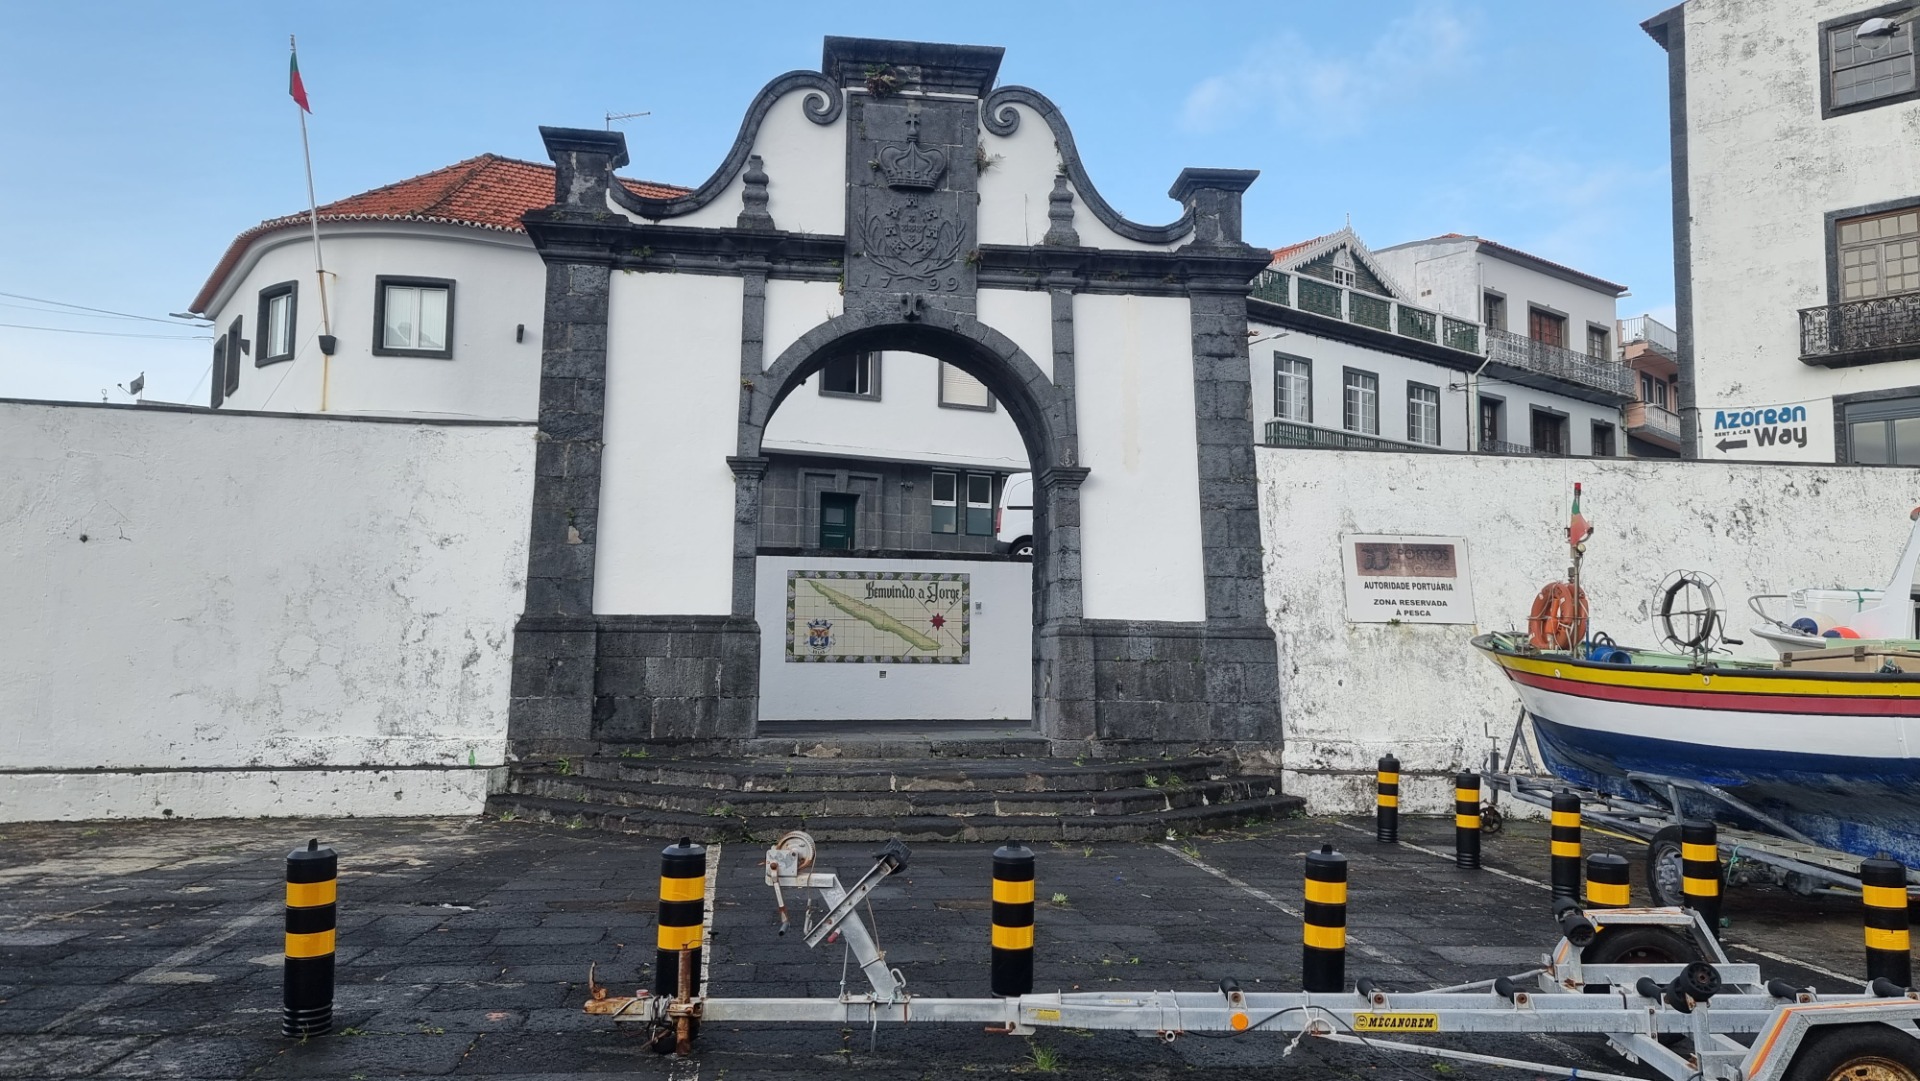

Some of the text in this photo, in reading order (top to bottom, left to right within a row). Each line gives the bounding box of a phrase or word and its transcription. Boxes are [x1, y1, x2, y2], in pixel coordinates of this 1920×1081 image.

[1714, 406, 1806, 430] Azorean
[1754, 426, 1808, 448] Way
[1364, 581, 1453, 591] AUTORIDADE PORTUÁRIA
[918, 588, 925, 599] a
[1399, 599, 1448, 607] RESERVADA
